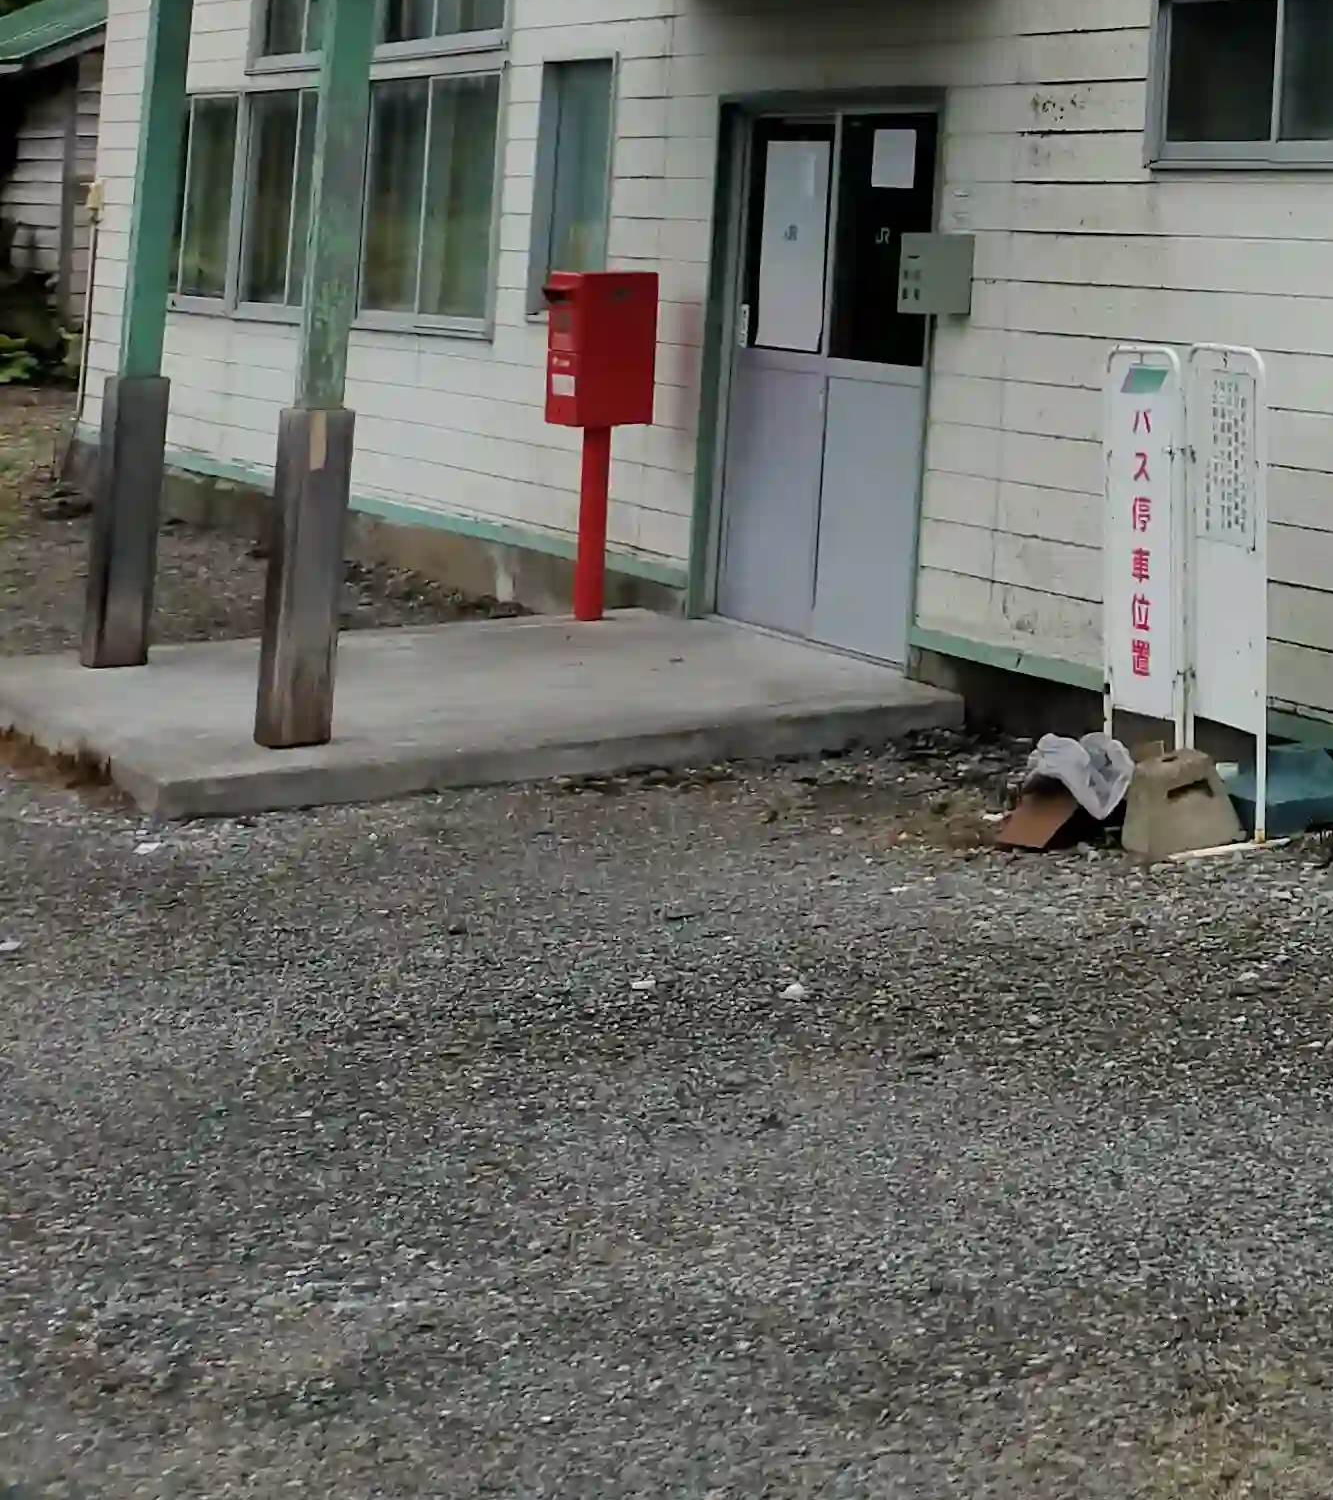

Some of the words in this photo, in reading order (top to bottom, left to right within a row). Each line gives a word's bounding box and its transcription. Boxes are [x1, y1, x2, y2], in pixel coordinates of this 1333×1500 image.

[875, 227, 890, 244] JR
[1131, 408, 1152, 677] バス停車位置
